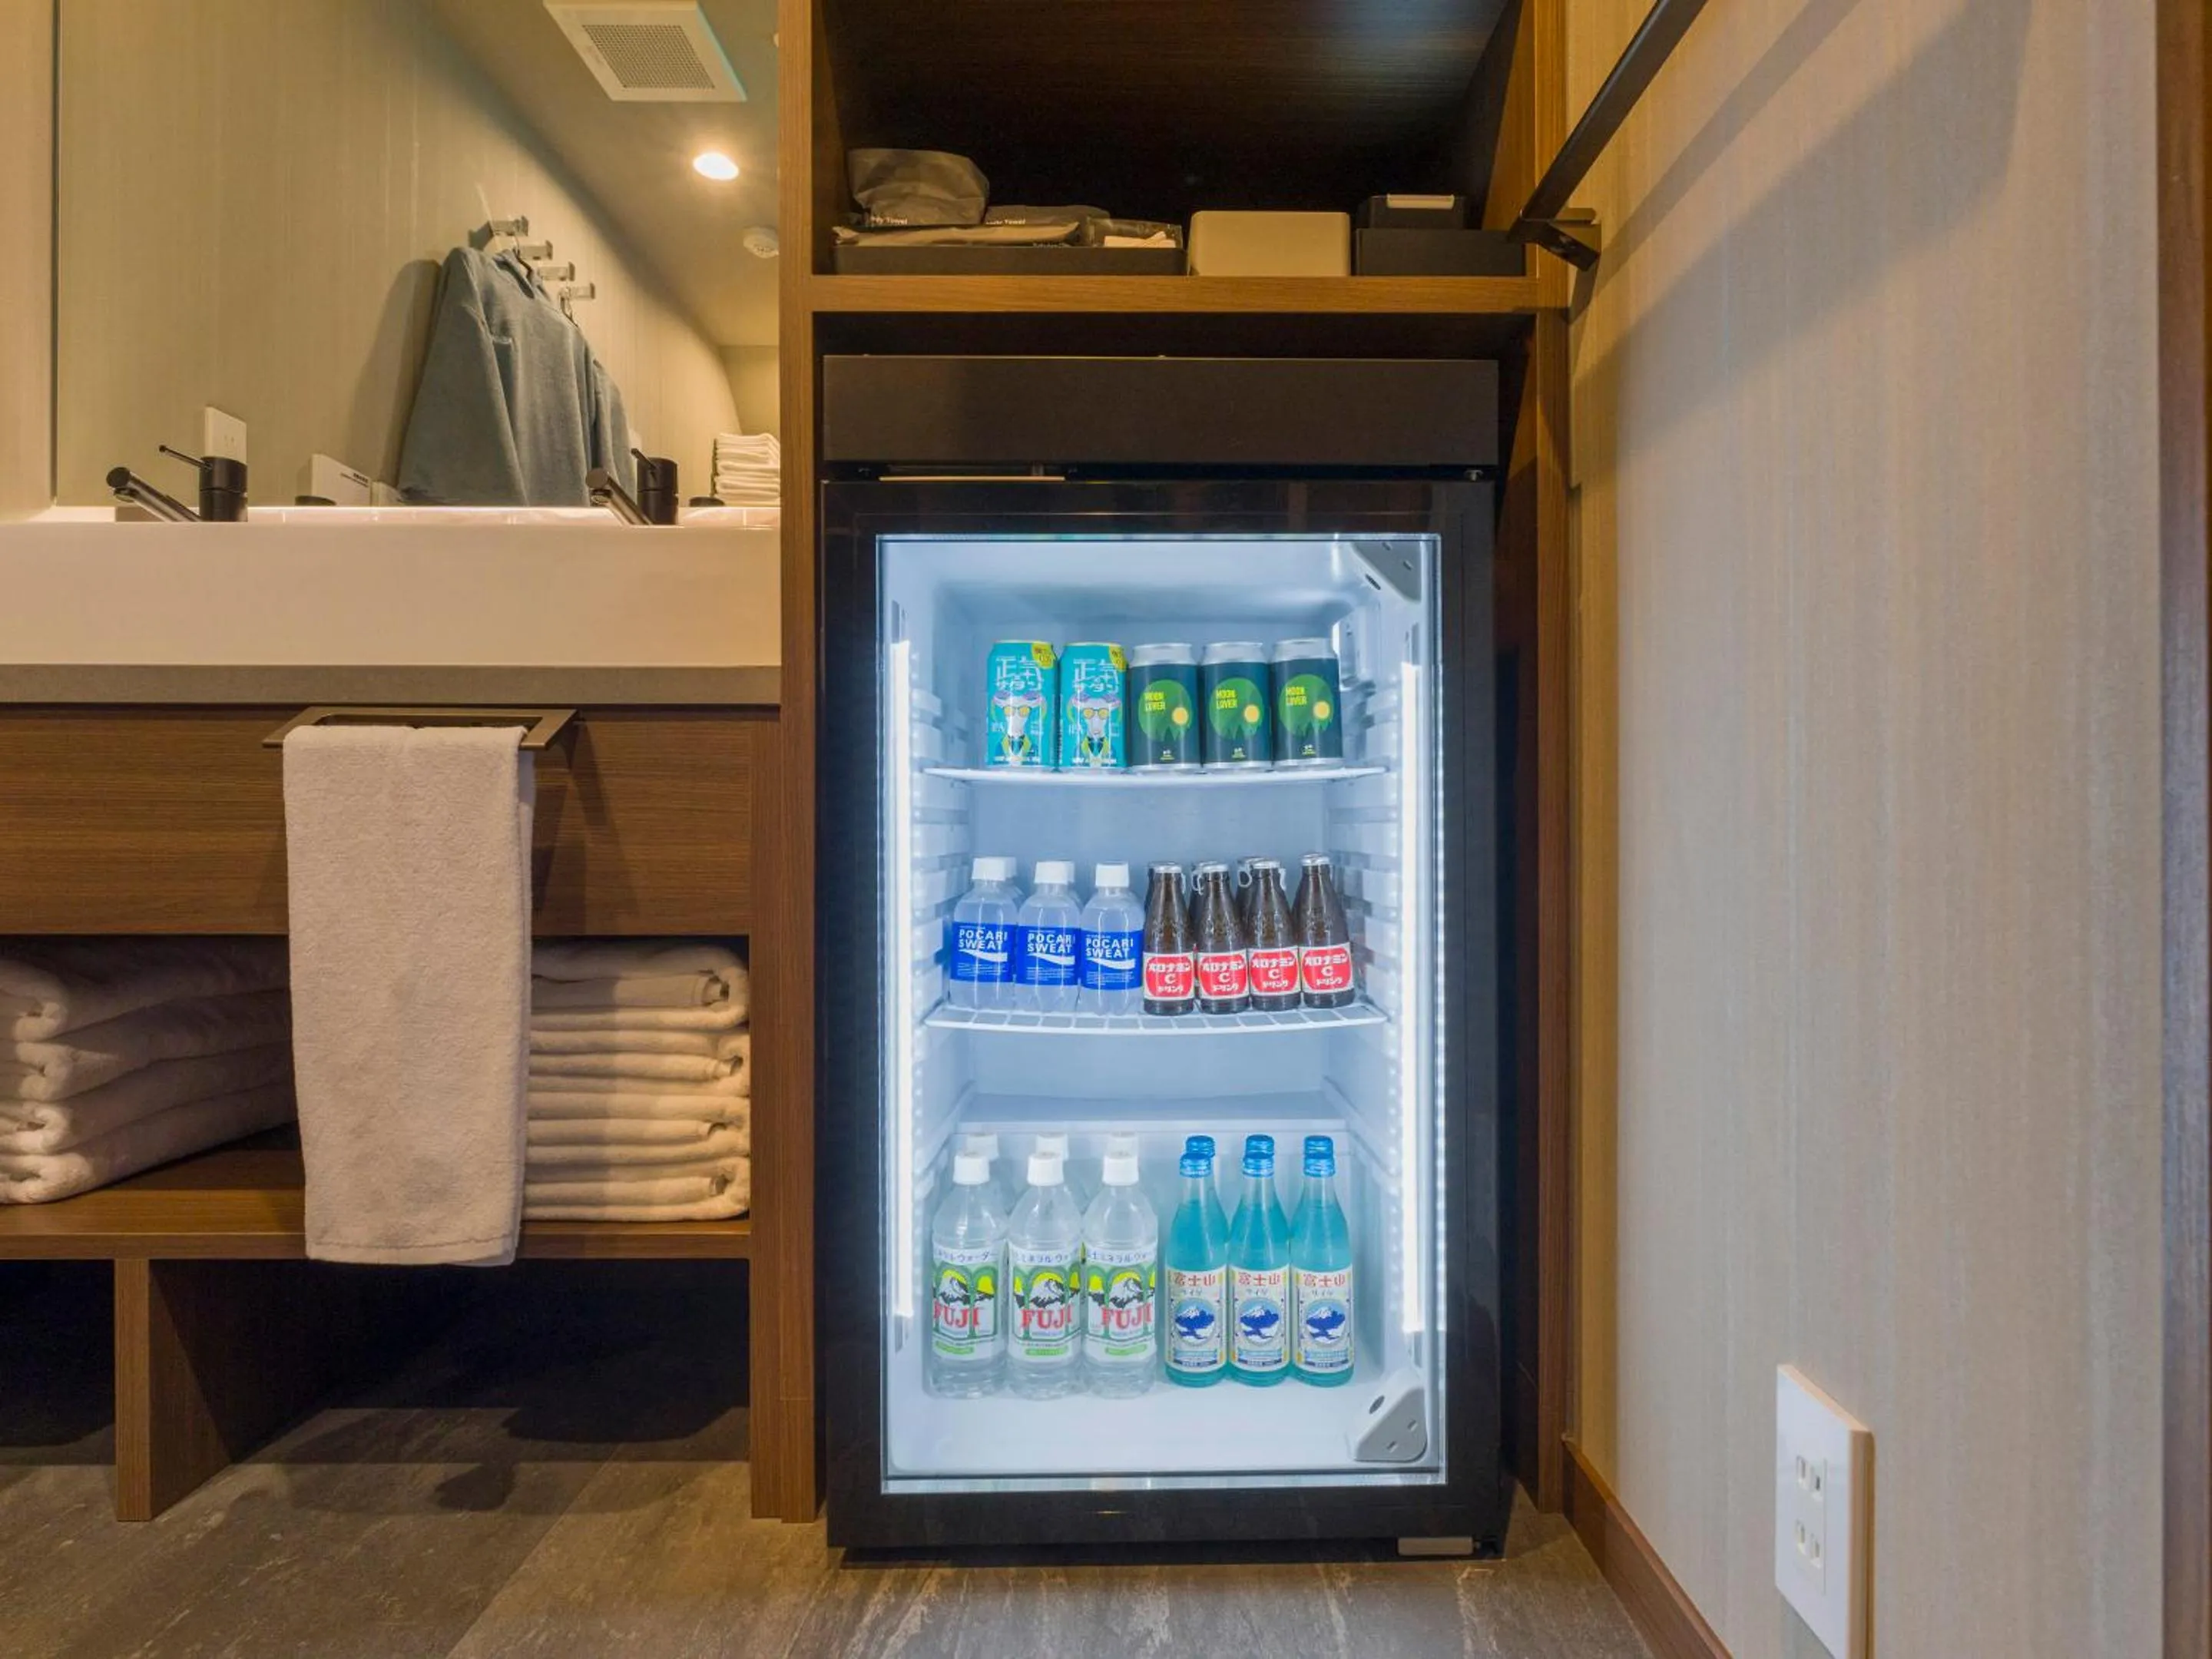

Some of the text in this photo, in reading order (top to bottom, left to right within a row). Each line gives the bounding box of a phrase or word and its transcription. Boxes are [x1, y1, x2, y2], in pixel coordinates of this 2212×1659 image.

[959, 928, 1008, 942] POCARI
[1028, 932, 1075, 944] POCARI
[958, 938, 1003, 951] SWEAT
[1028, 942, 1072, 953] SWEAT
[1086, 937, 1134, 949] POCARI
[1086, 947, 1130, 959] SWEAT
[1268, 969, 1280, 979] C
[1321, 965, 1333, 976] C
[1164, 973, 1176, 985] C
[1219, 972, 1230, 983] C
[1174, 1272, 1216, 1286] 富士山
[1238, 1272, 1280, 1286] 富士山
[1303, 1273, 1346, 1288] 富士山
[933, 1298, 980, 1328] FUJI
[1021, 1304, 1072, 1330] FUJI
[1101, 1303, 1153, 1330] FUJI
